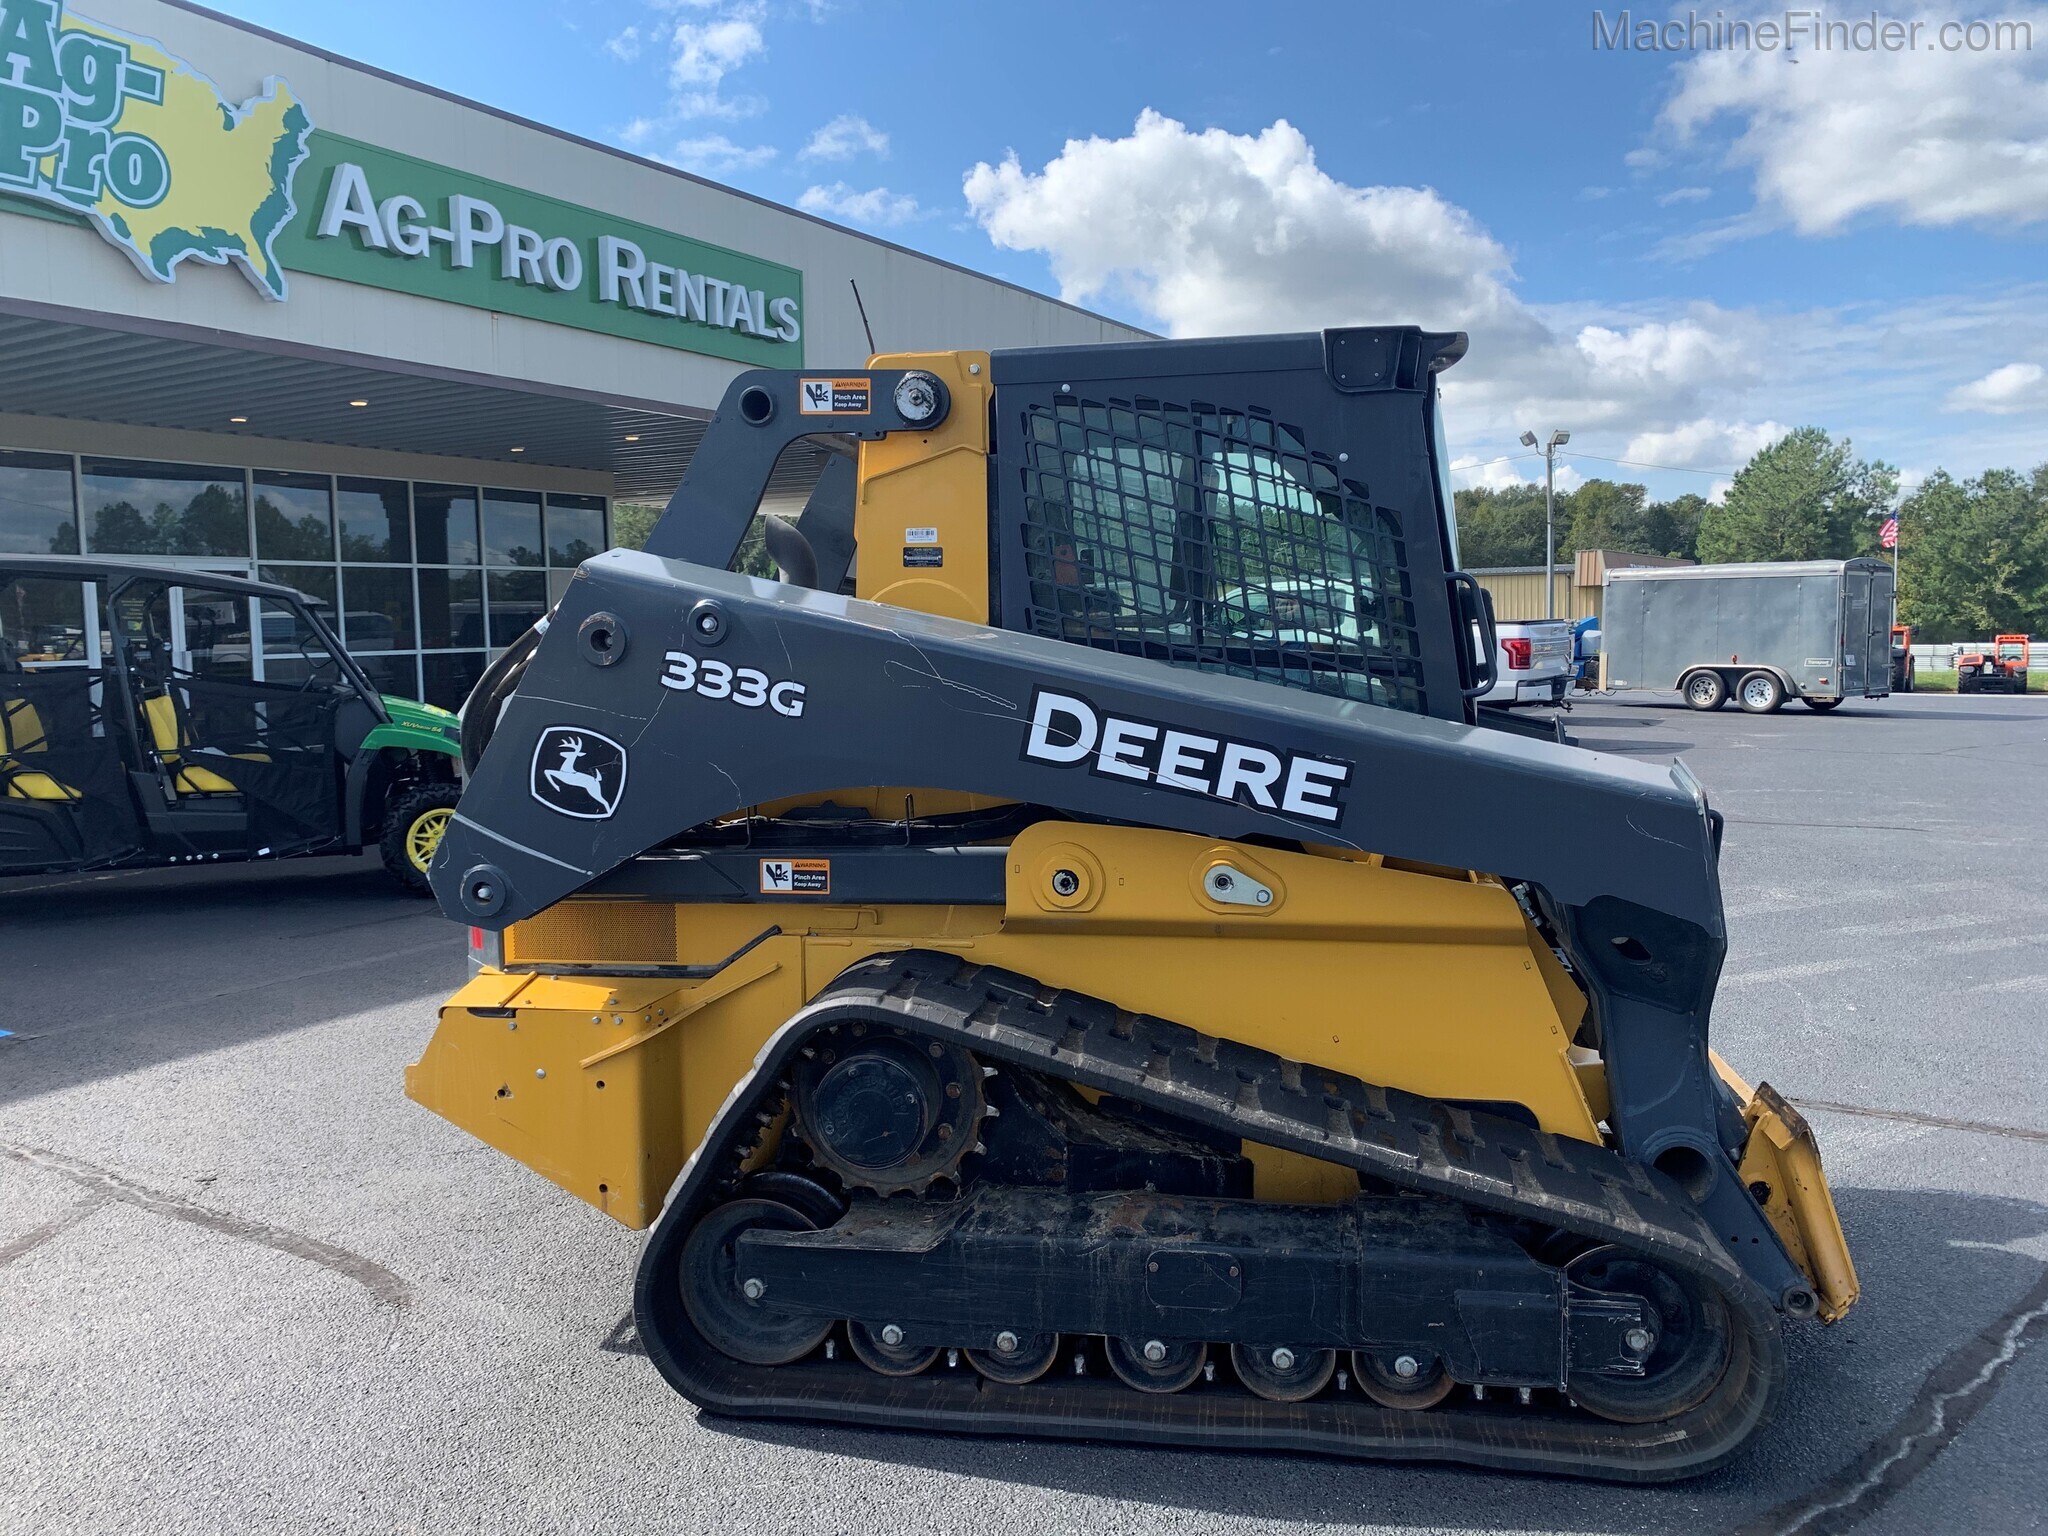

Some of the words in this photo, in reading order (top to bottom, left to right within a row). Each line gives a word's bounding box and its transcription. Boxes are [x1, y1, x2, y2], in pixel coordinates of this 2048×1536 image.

[0, 81, 169, 207] Pro
[317, 162, 583, 292] AG-PRO
[597, 234, 800, 343] RENTALS
[660, 651, 806, 717] 333G
[1026, 691, 1348, 821] DEERE
